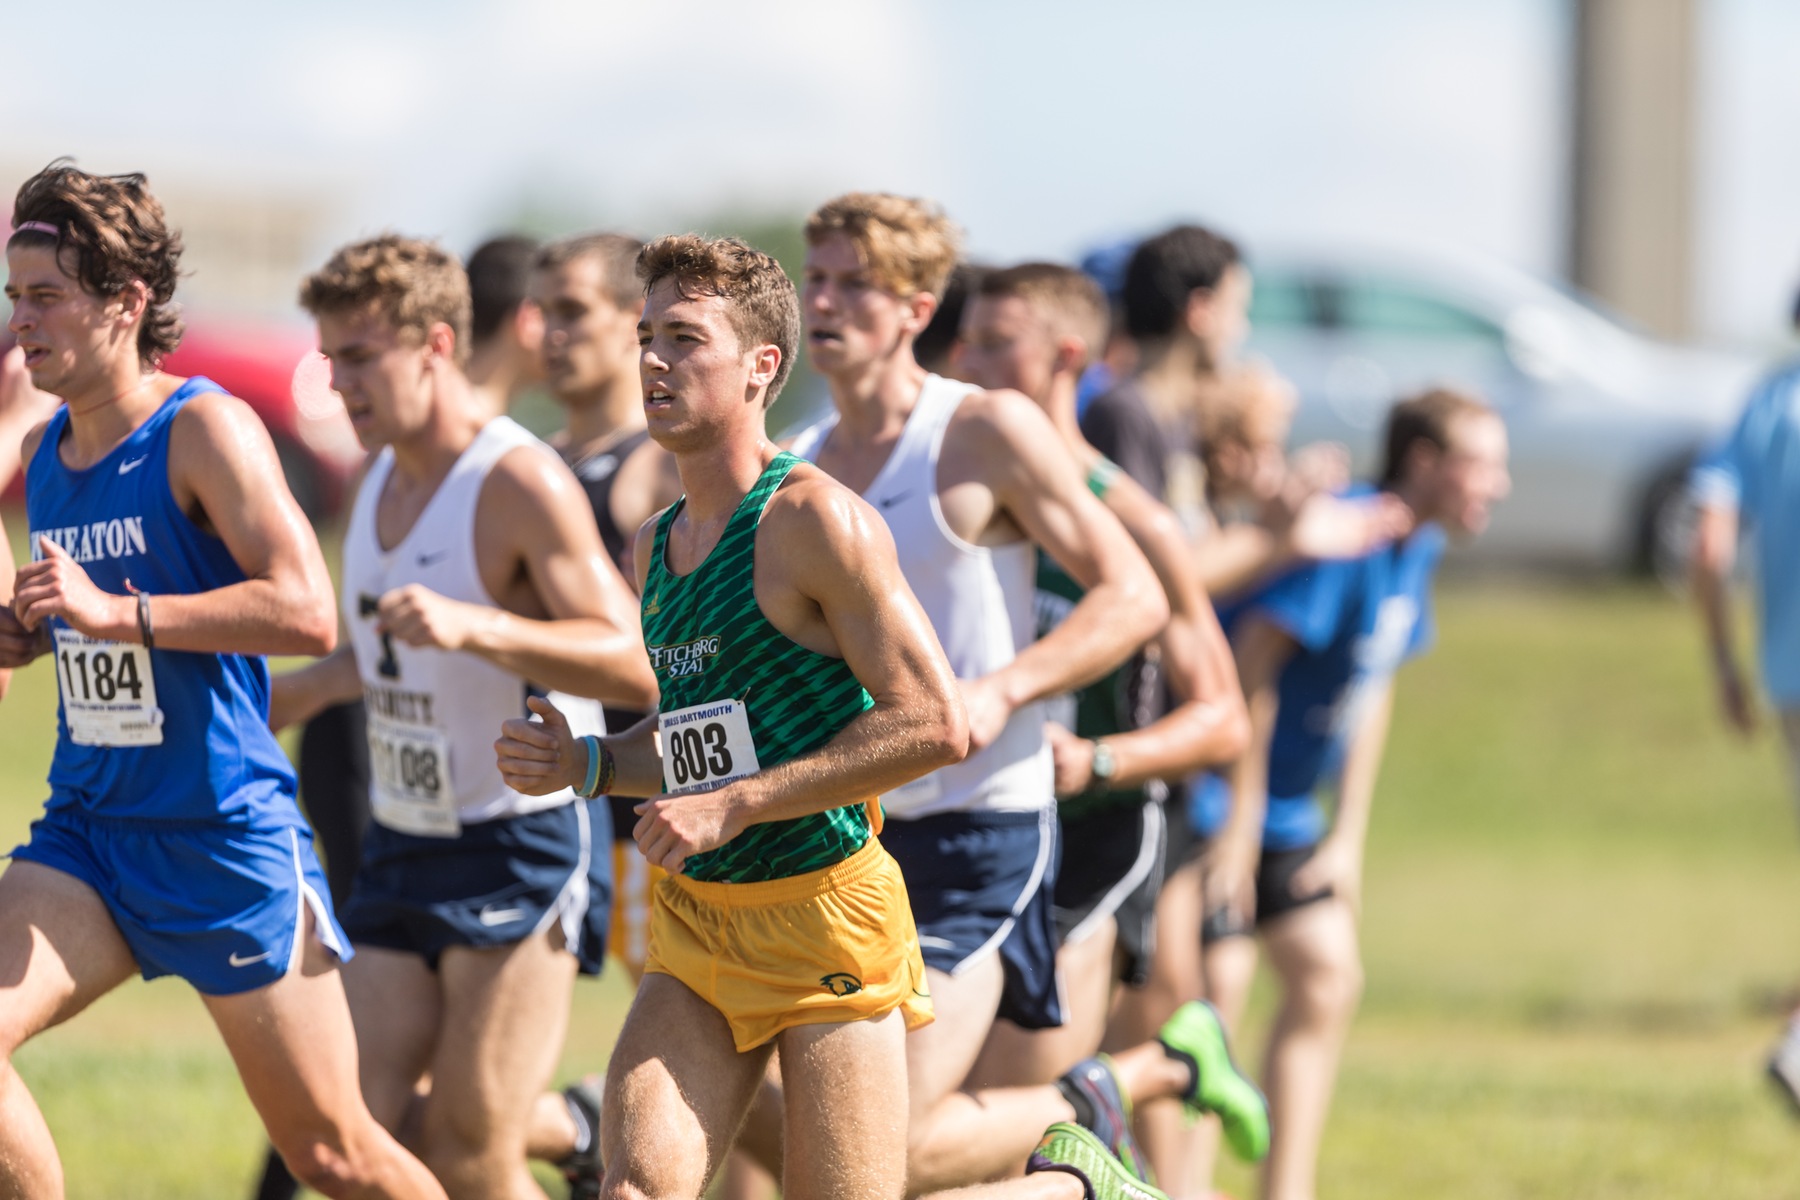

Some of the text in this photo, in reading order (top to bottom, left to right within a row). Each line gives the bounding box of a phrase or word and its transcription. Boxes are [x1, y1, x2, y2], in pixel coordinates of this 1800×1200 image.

[648, 637, 719, 668] FITCHBRG
[669, 657, 704, 678] STAT
[61, 650, 142, 701] 1184
[680, 704, 733, 724] DARTMOUTH
[670, 722, 733, 785] 803
